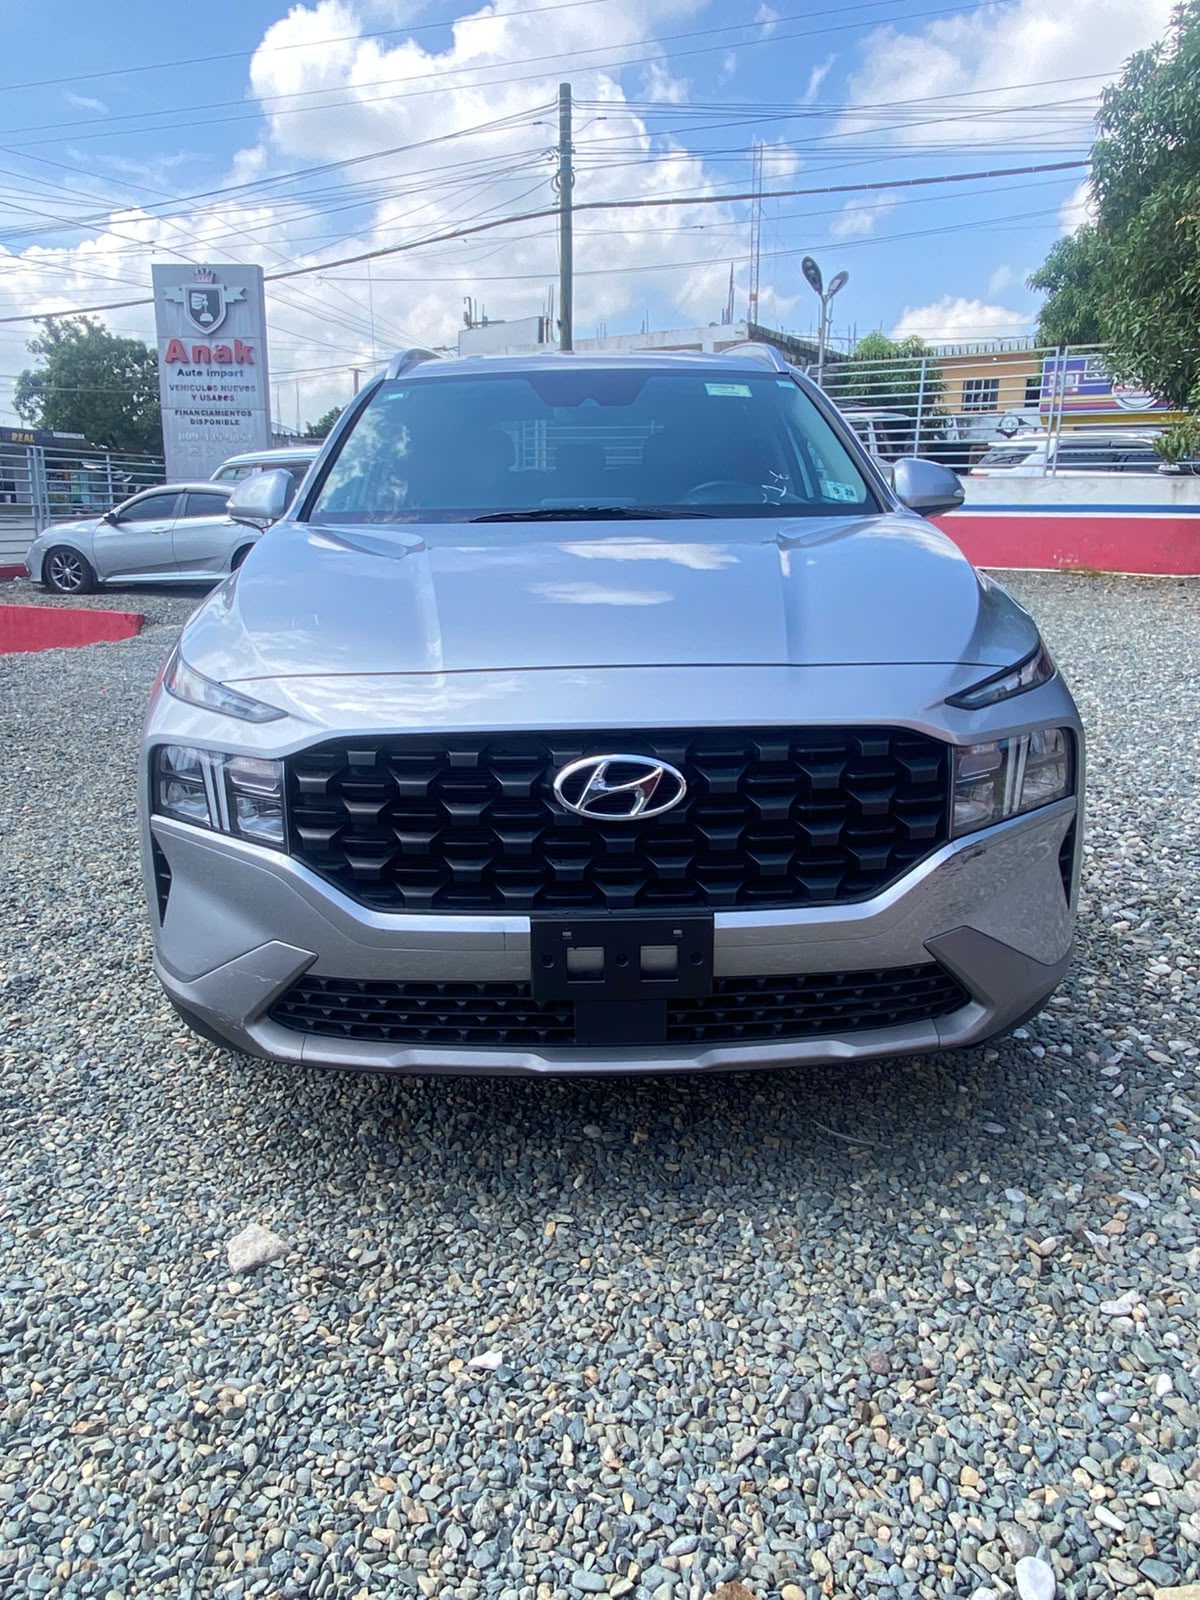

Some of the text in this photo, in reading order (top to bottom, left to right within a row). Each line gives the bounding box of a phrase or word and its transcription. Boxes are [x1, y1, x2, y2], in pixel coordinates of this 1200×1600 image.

[164, 338, 255, 365] Anak
[177, 368, 244, 379] Auto import
[169, 384, 256, 393] VEHICULOS NUEVOS
[191, 394, 235, 402] Y USADOS
[174, 409, 253, 417] FINANCIAMIENTOS
[190, 418, 241, 426] DISPONIBLE
[11, 432, 34, 443] REAL
